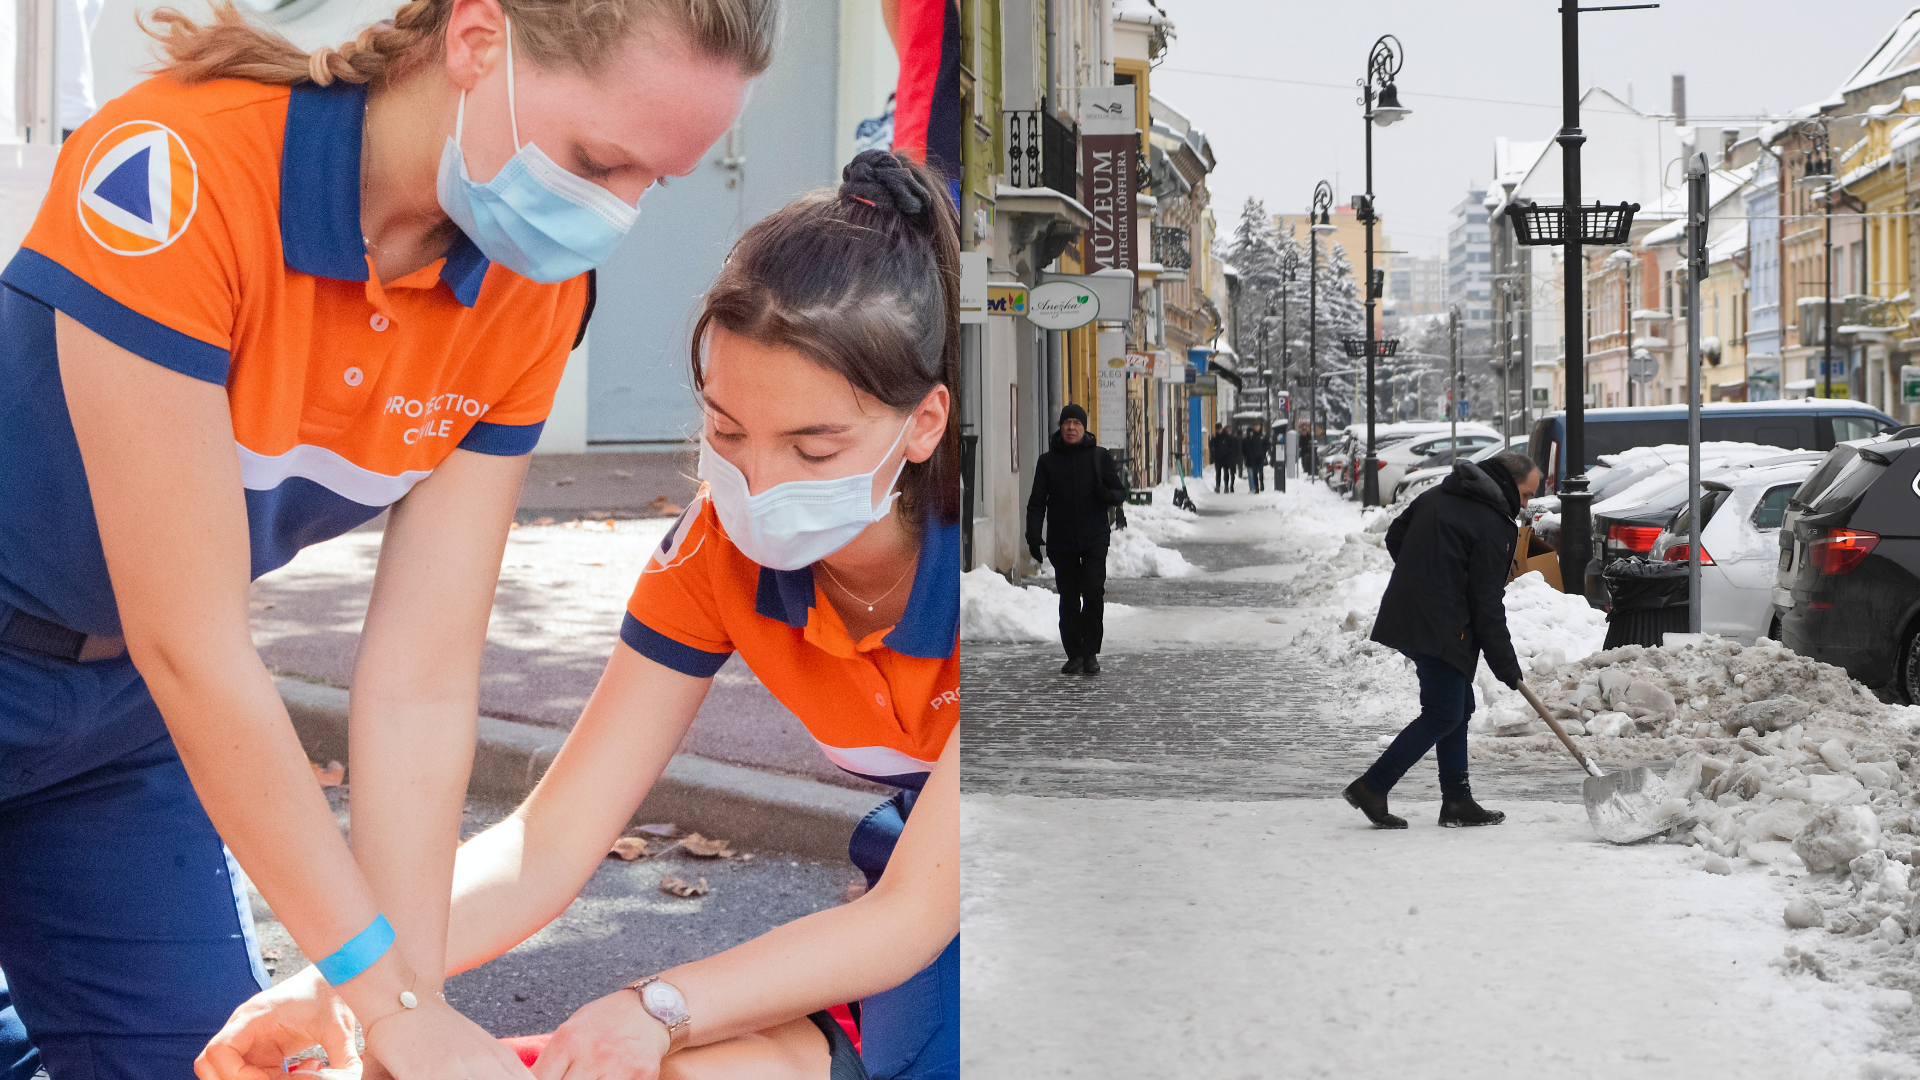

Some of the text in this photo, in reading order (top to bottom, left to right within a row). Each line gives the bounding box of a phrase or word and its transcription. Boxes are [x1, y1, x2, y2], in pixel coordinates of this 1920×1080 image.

[1090, 150, 1115, 271] MÚZEUM
[1118, 215, 1129, 270] OJTECHA
[383, 393, 490, 418] PROECTIO
